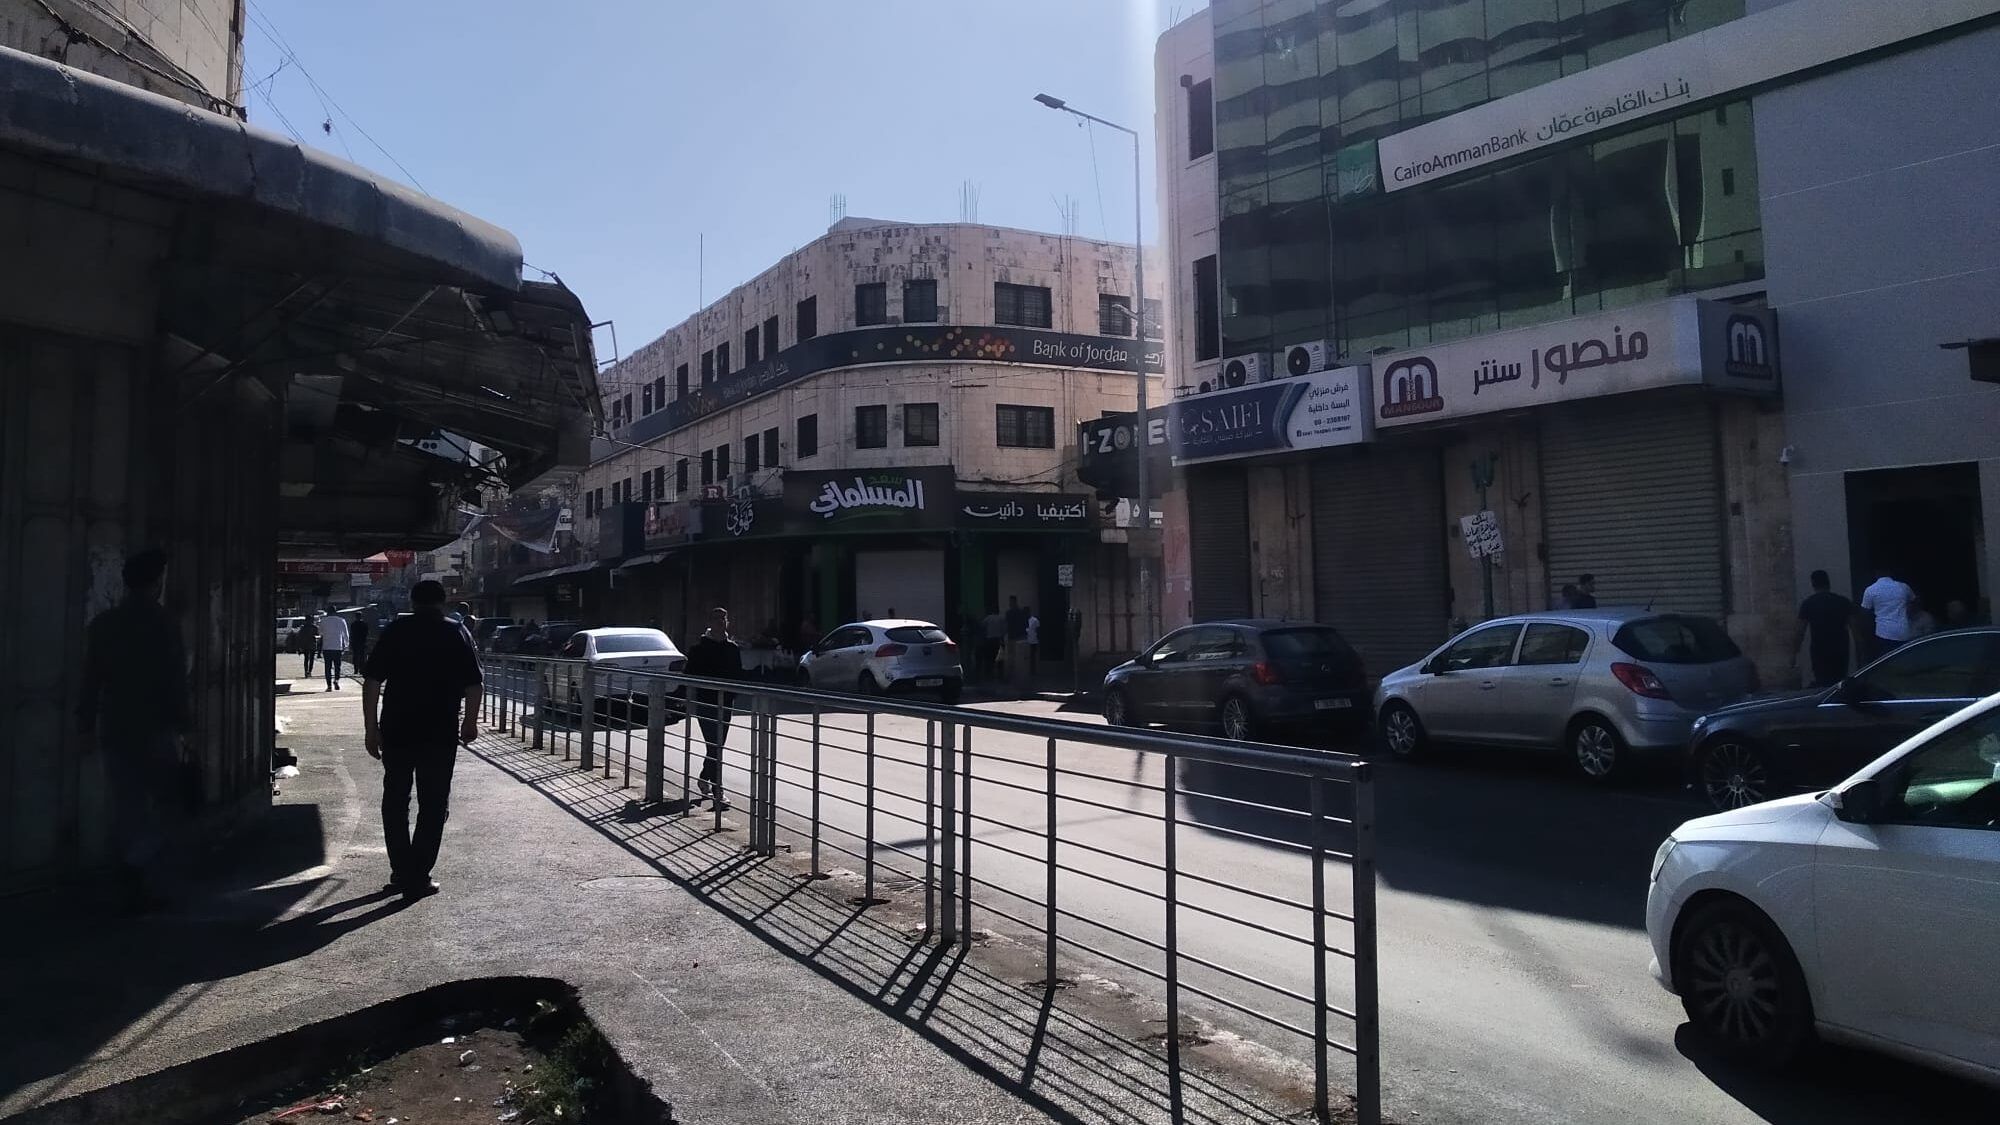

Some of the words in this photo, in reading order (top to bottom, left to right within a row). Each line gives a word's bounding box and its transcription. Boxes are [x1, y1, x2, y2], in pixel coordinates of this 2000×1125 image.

[1584, 90, 1646, 124] القاهرة
[1648, 77, 1691, 104] بنك
[1393, 129, 1528, 182] CairoAmmanBank
[1033, 339, 1066, 359] Bank
[1070, 342, 1084, 358] of
[1530, 325, 1649, 391] منصور
[1473, 359, 1522, 396] سنتر
[1202, 401, 1262, 434] SAIFI
[810, 477, 924, 518] المسلماني
[962, 501, 1024, 520] دانيت
[1037, 500, 1086, 520] أكتيفيا
